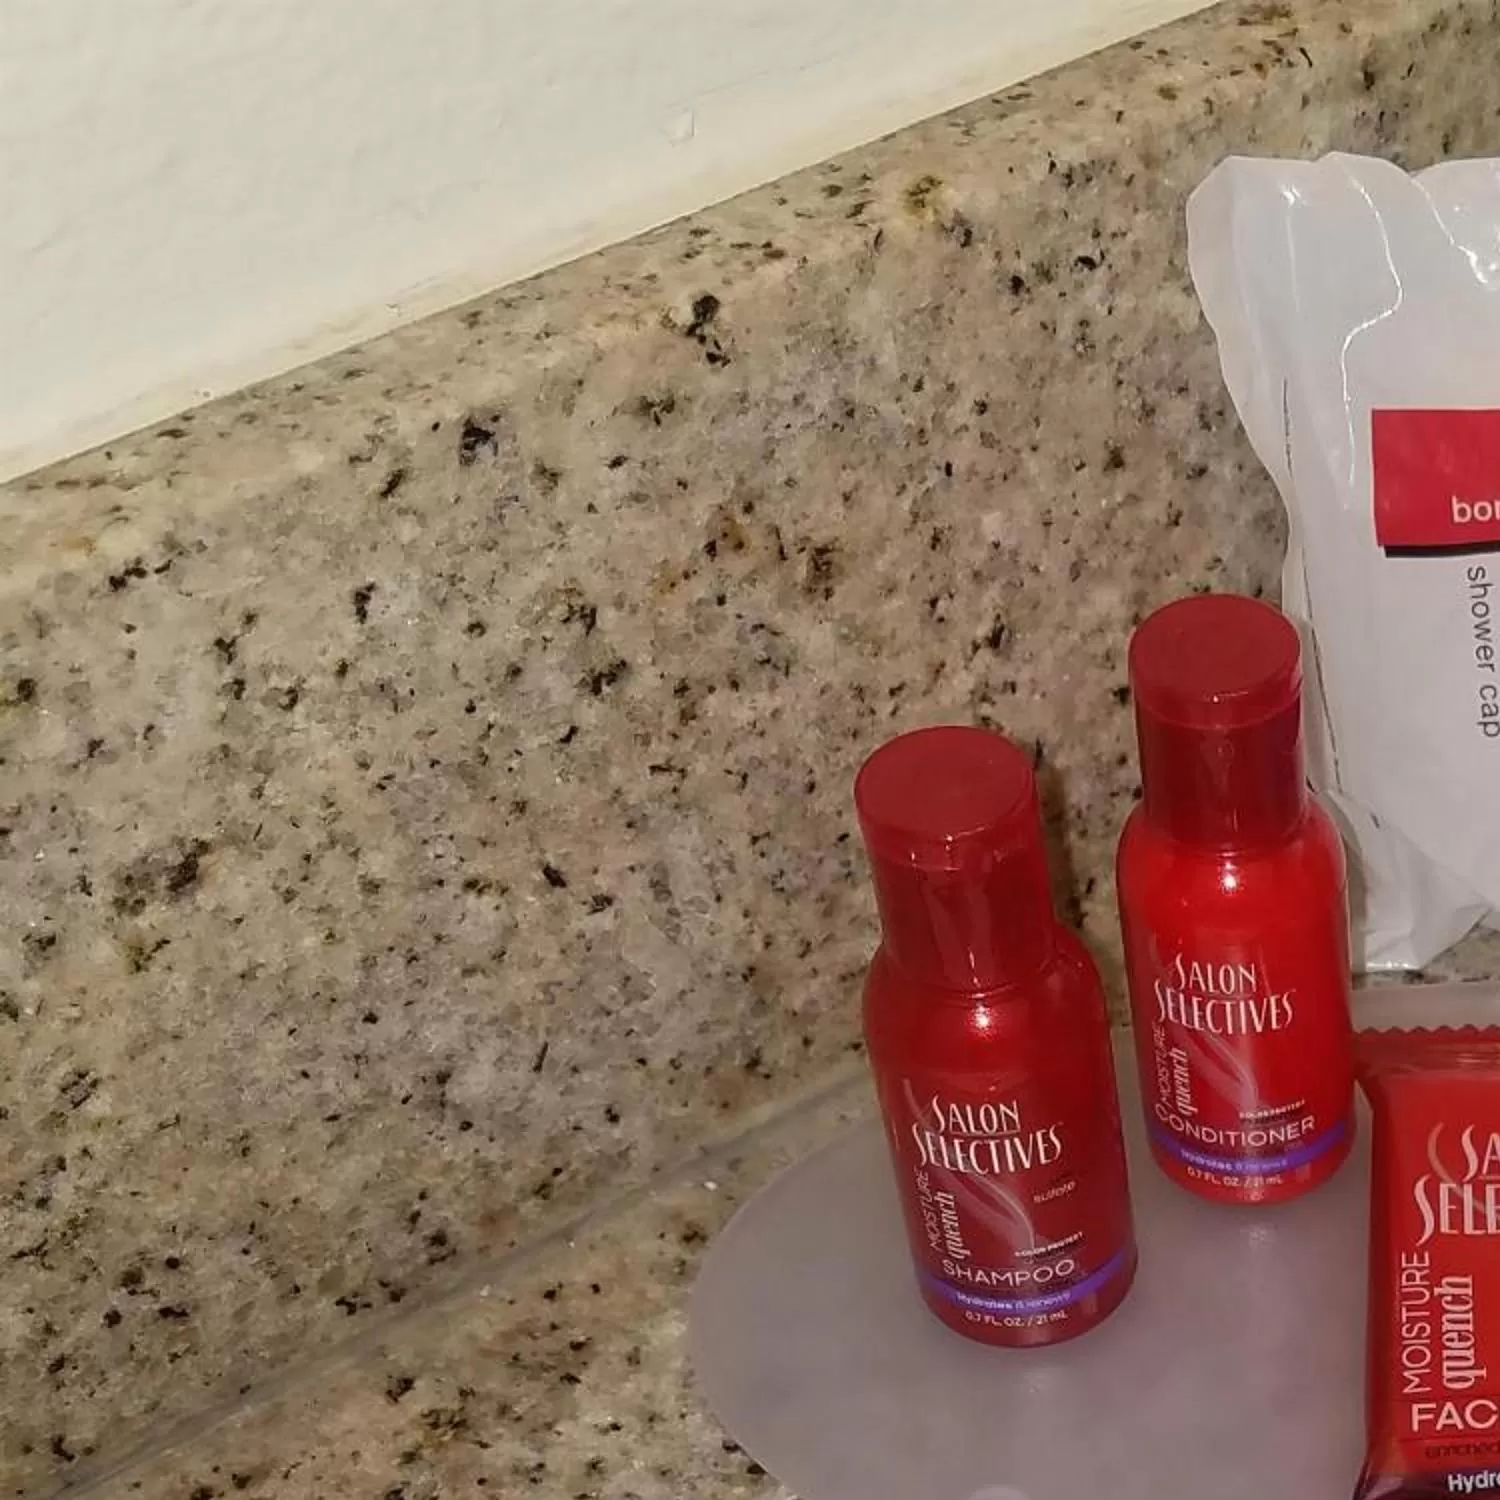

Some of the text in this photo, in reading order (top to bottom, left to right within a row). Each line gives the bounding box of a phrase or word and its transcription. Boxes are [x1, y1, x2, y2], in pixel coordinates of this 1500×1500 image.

[1465, 565, 1496, 673] shower
[1174, 952, 1257, 994] SALON
[1154, 978, 1293, 1035] SELECTIVES
[1170, 1047, 1198, 1116] quench
[931, 1093, 1021, 1134] SALON
[1155, 1102, 1316, 1148] CONDITIONER
[912, 1122, 1062, 1175] SELECTIVES
[934, 1190, 971, 1260] quench
[943, 1259, 1075, 1287] SHAMPOO
[1400, 1250, 1432, 1395] MOISTURE
[1434, 1274, 1487, 1391] quench
